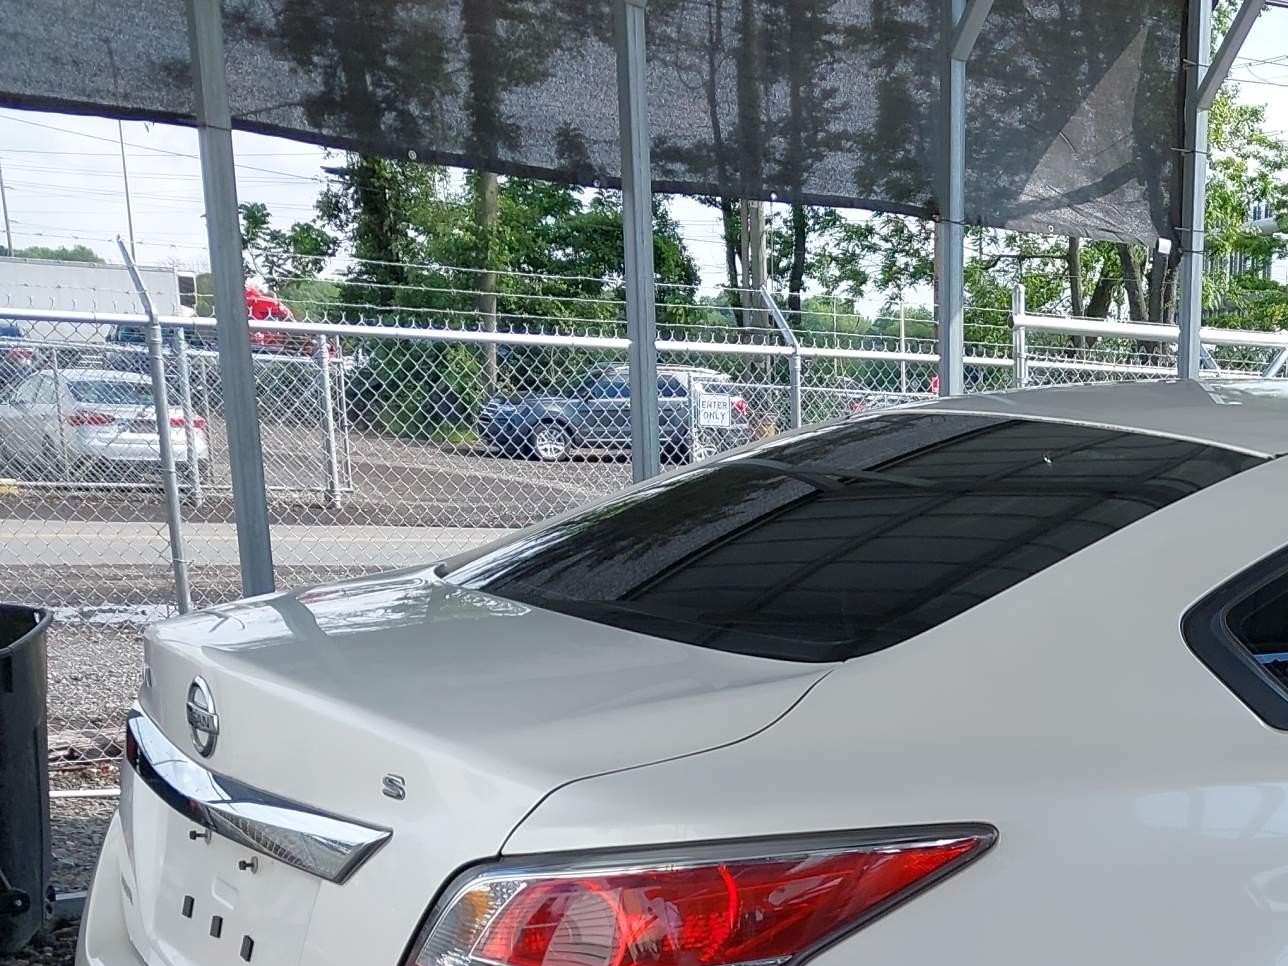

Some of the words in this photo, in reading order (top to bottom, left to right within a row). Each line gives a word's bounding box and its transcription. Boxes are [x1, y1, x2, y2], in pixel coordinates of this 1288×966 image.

[701, 400, 728, 410] ENTER
[703, 411, 726, 421] ONLY
[382, 773, 406, 801] S
